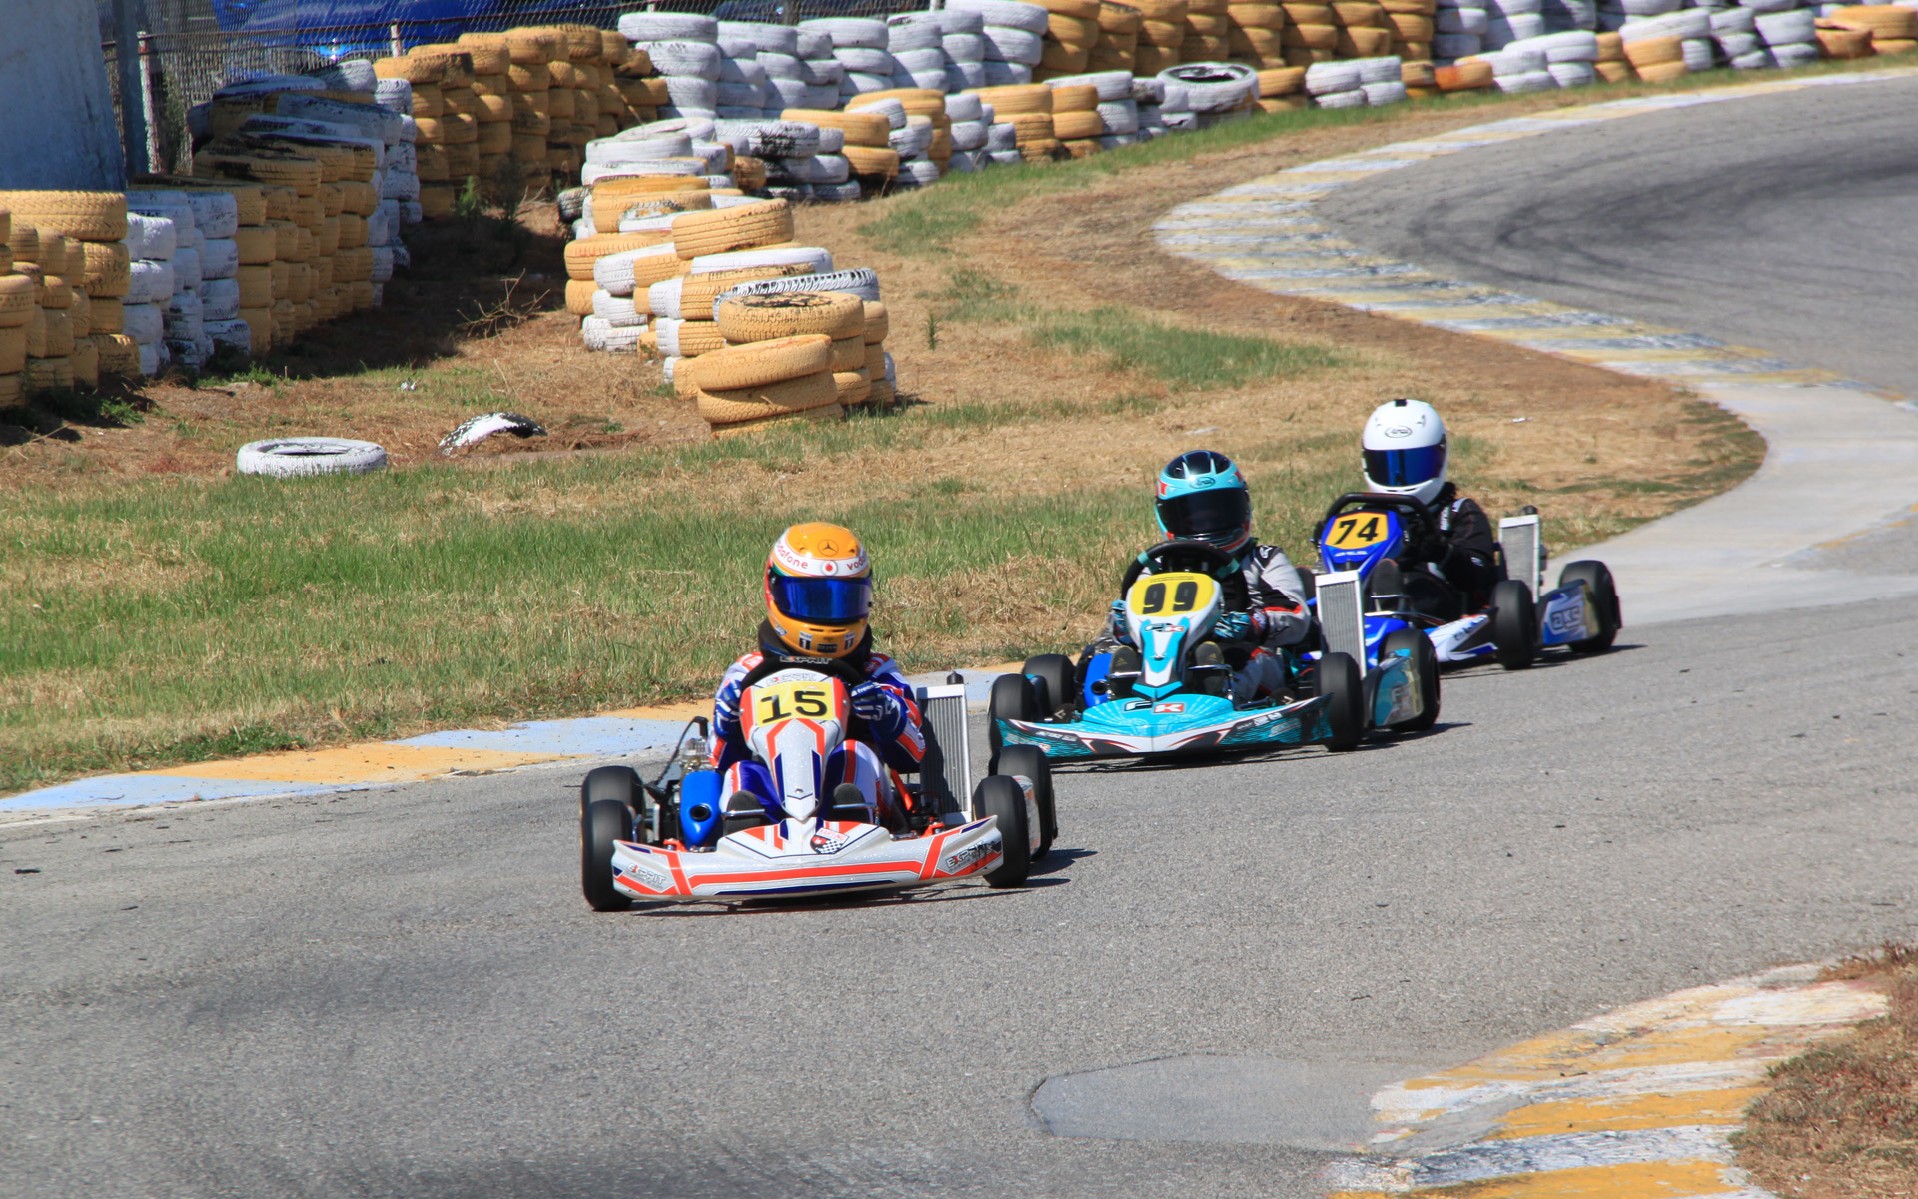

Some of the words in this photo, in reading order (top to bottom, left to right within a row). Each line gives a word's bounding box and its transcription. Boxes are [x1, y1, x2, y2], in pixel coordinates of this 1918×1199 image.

[1333, 516, 1379, 546] 74
[1142, 581, 1198, 615] 99
[760, 690, 828, 724] 15
